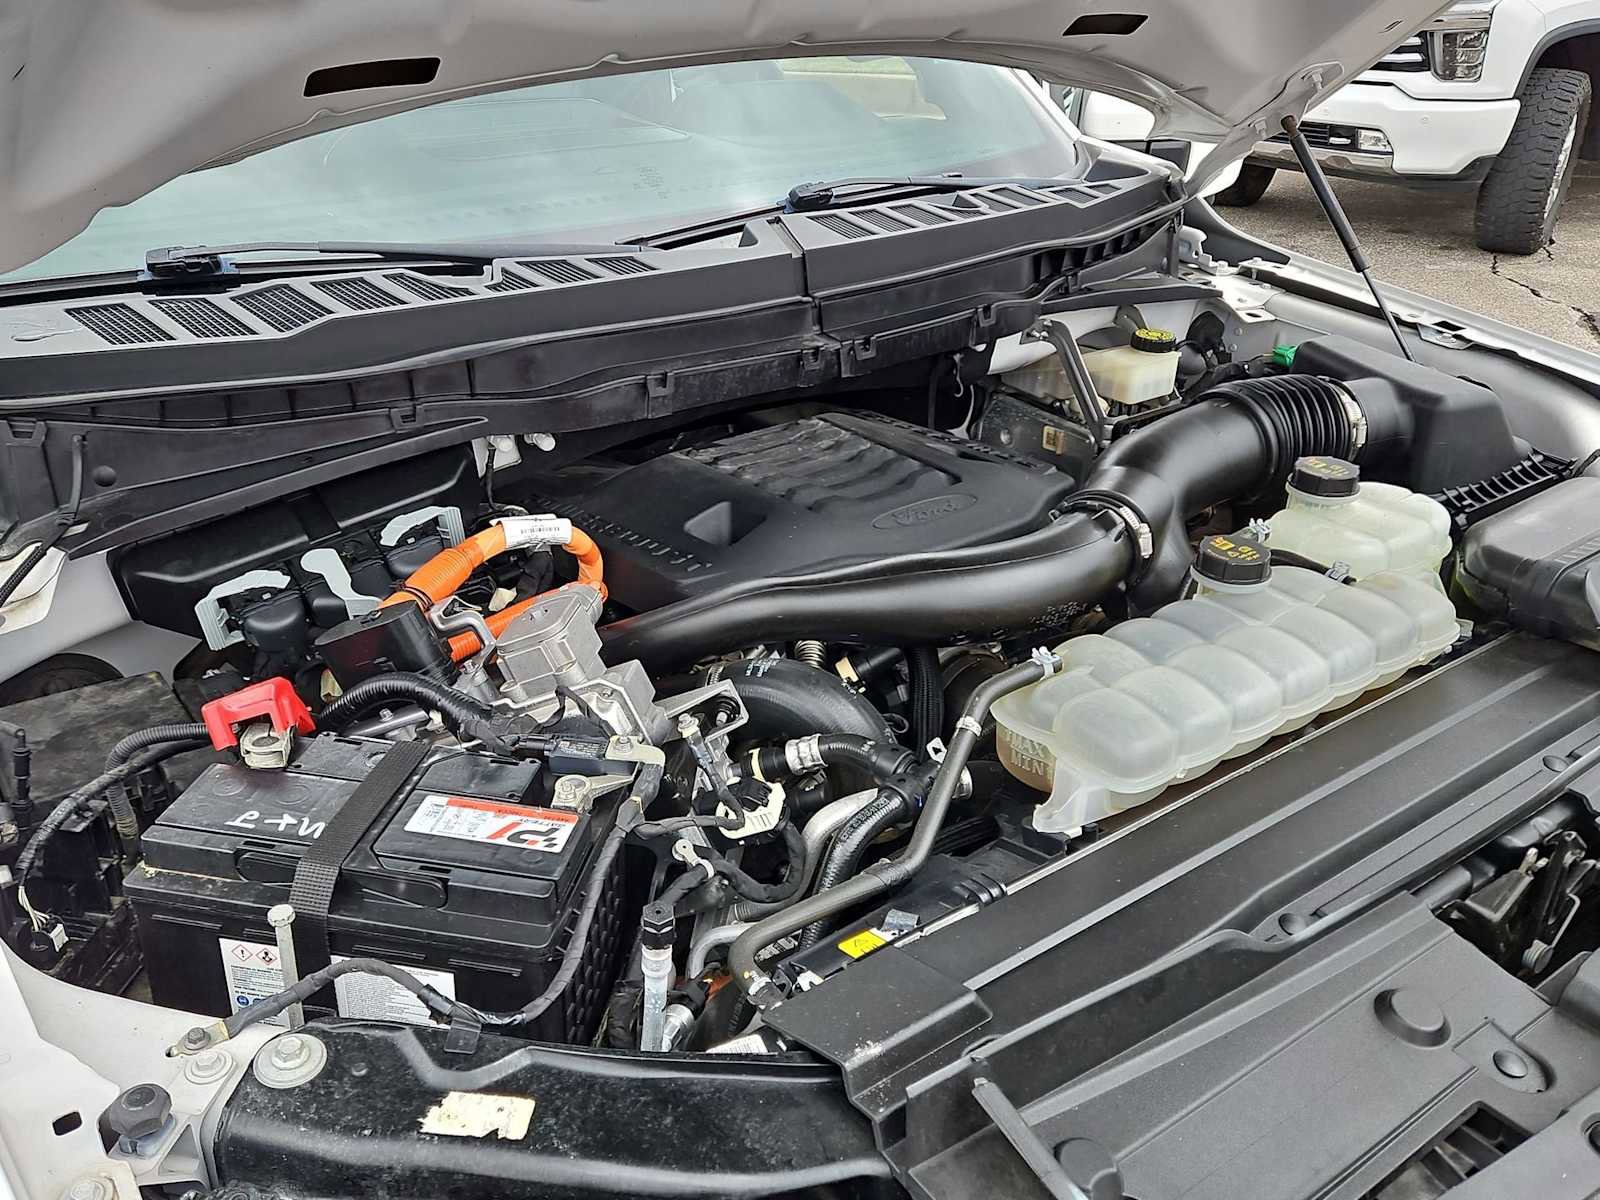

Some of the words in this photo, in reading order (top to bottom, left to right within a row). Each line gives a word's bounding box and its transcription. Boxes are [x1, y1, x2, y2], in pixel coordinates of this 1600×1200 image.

[892, 500, 958, 527] Ford
[1010, 733, 1045, 758] MAX
[1010, 749, 1044, 776] MIN
